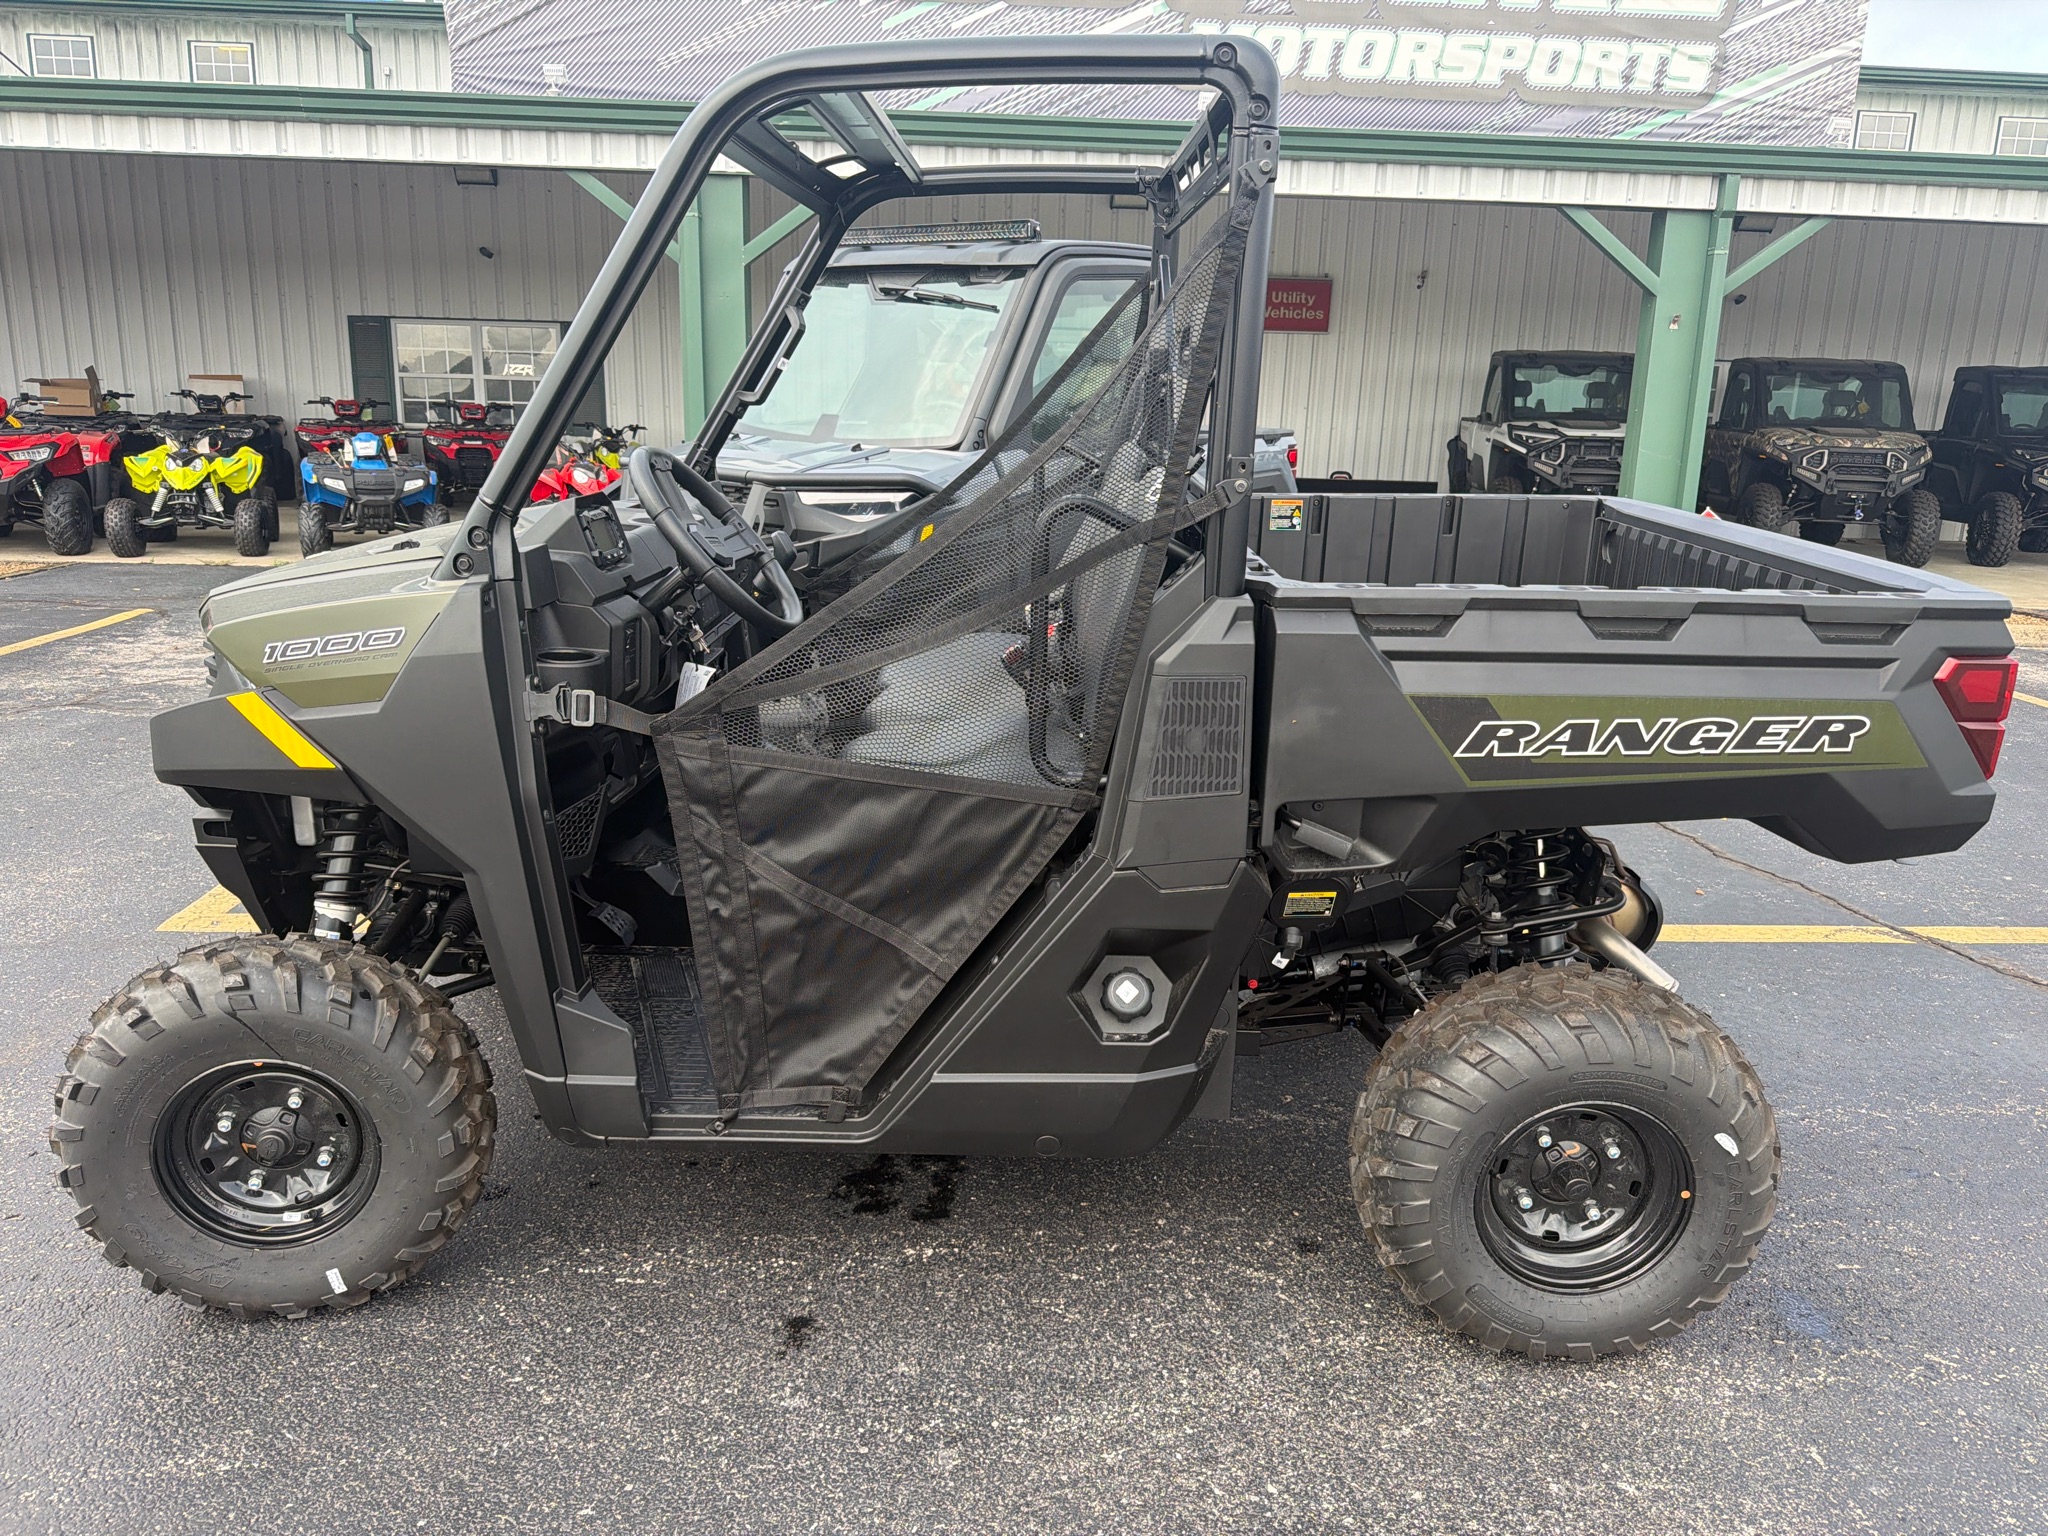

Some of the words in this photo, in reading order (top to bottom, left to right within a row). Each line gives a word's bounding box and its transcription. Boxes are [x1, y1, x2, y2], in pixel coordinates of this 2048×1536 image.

[1194, 23, 1716, 92] OTORSPORTS
[1271, 291, 1316, 306] Utility
[262, 626, 406, 664] 1000
[263, 663, 305, 674] SINGLE
[308, 655, 370, 668] OVERHEAD
[372, 651, 398, 660] CAM
[1453, 715, 1871, 758] RANGER
[292, 1026, 407, 1105] CARLSTAR
[1698, 1160, 1746, 1279] CARLSTAR
